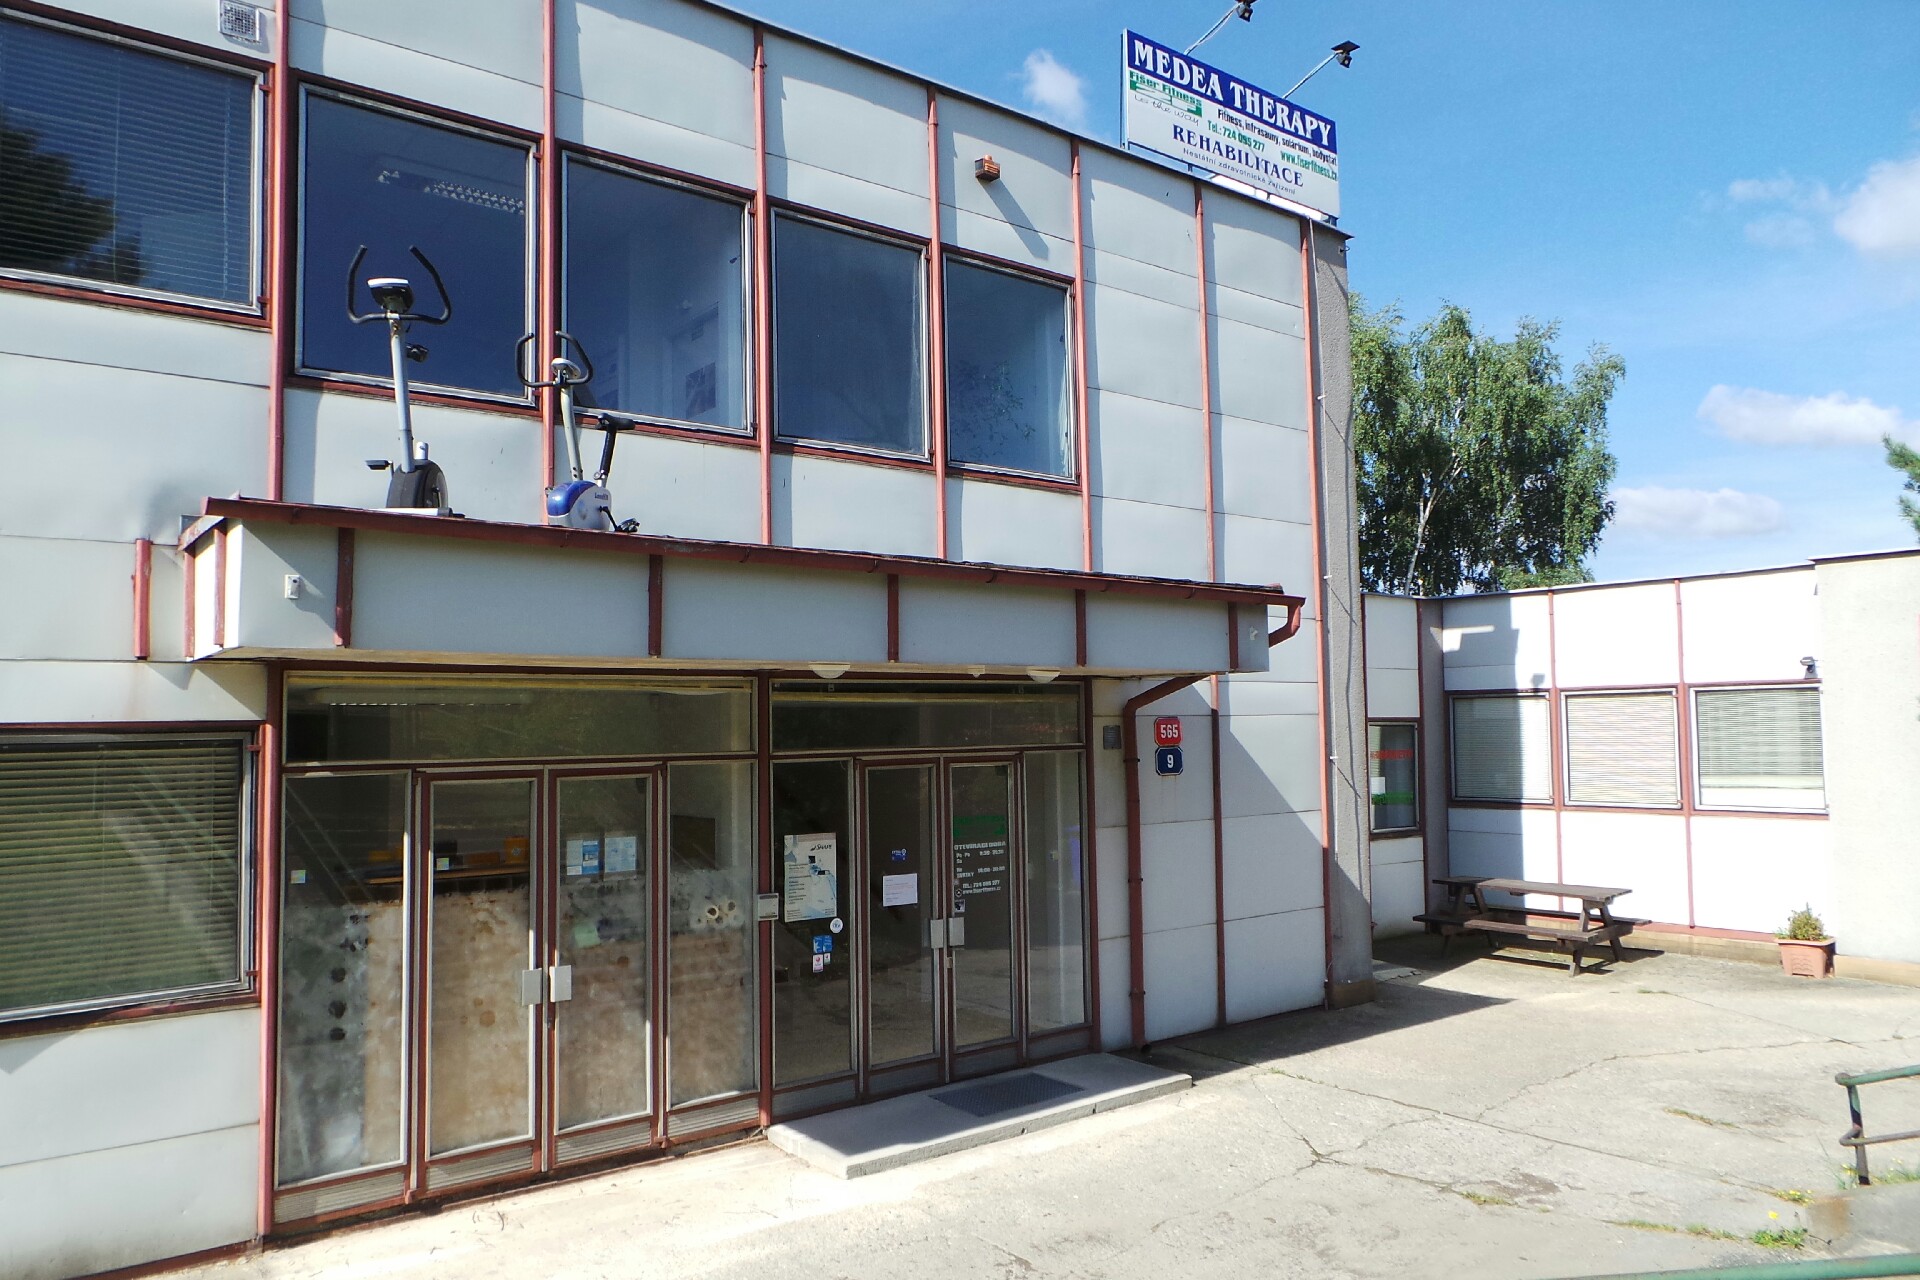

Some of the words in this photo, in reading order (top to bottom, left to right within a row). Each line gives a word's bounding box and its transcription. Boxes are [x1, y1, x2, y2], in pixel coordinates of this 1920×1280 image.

[1134, 39, 1224, 101] MEDEA
[1229, 81, 1331, 146] THERAPY
[1162, 84, 1202, 106] Fitness
[1217, 108, 1245, 130] Fitness,
[1245, 119, 1280, 146] infrasauny,
[1222, 126, 1237, 141] 724
[1238, 132, 1252, 147] 095
[1253, 139, 1265, 152] 277
[1172, 123, 1304, 188] REHABILITACE
[1183, 147, 1216, 165] Nestátní
[1218, 161, 1266, 183] zdravotnické
[1160, 724, 1179, 739] 565
[1167, 754, 1174, 769] 9
